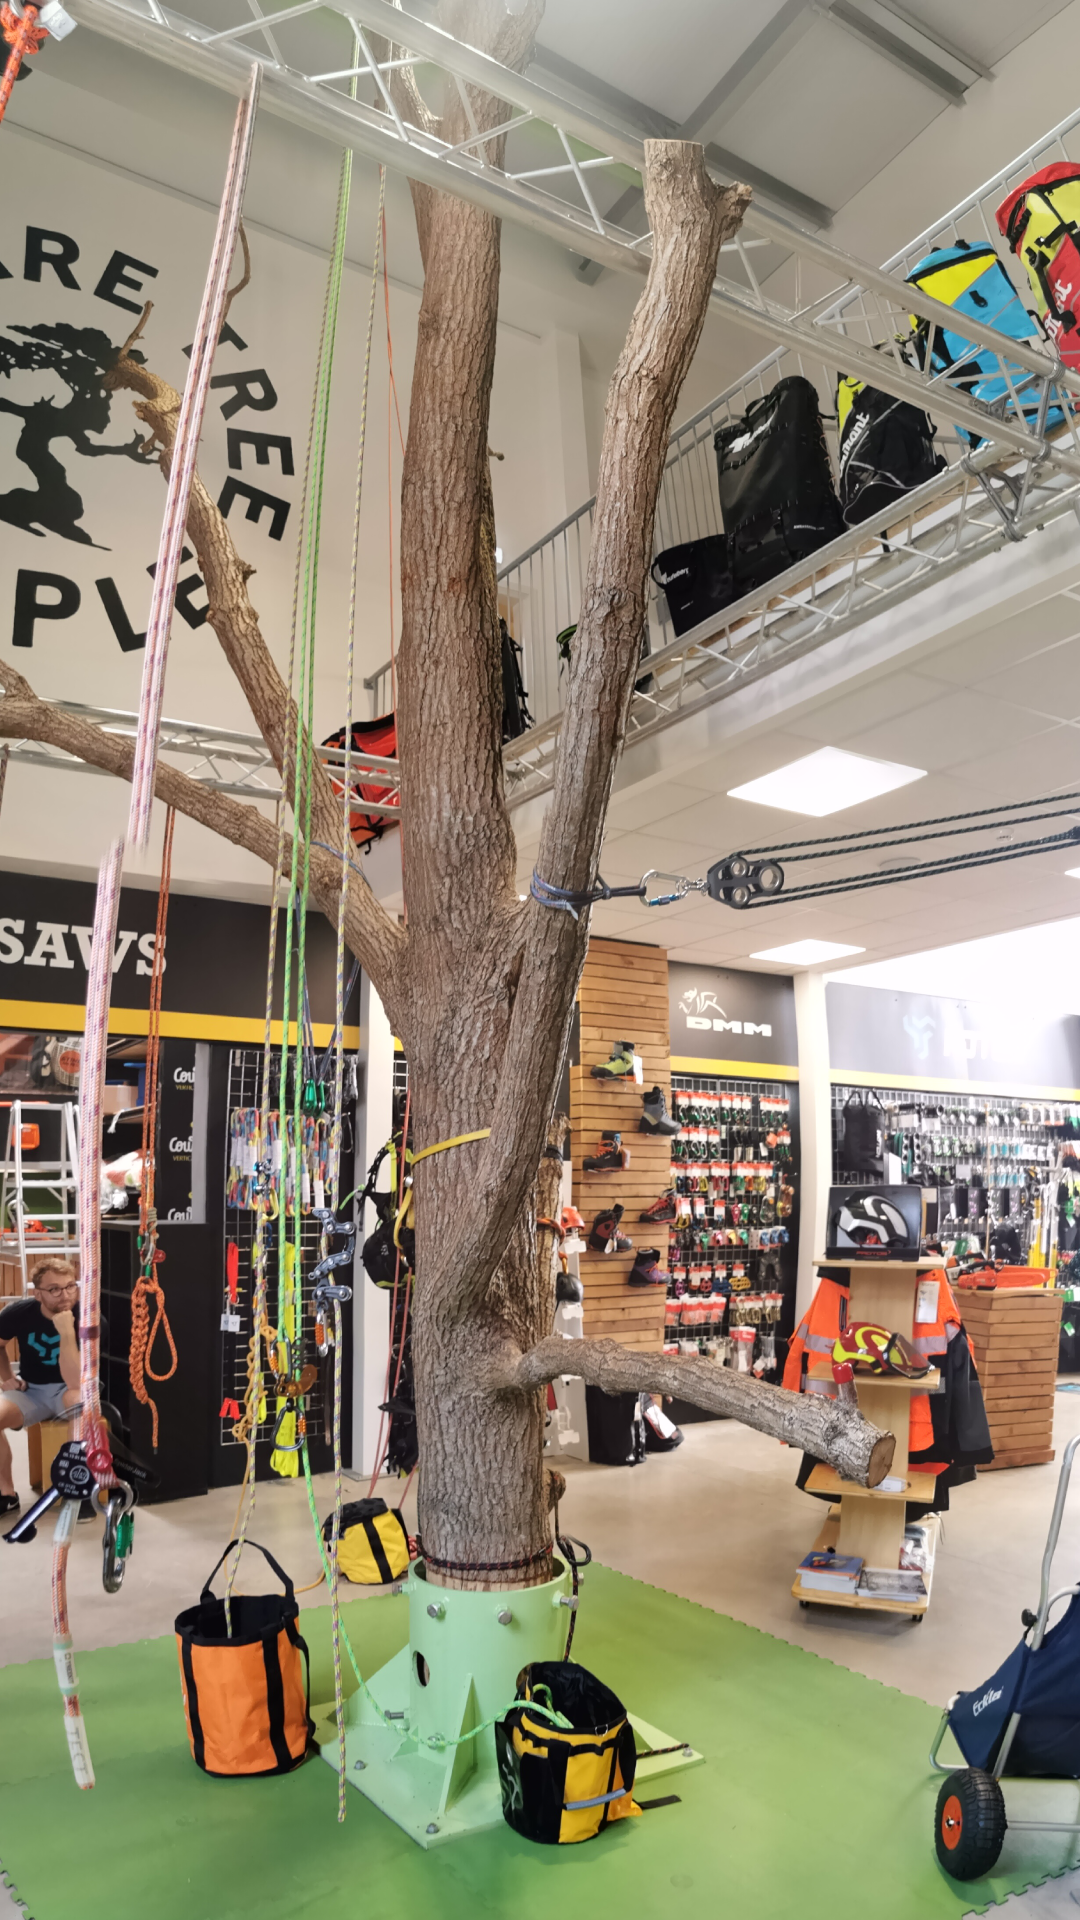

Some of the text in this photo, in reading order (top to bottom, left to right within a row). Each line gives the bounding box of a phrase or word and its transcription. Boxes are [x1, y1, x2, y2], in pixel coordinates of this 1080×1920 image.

[0, 226, 159, 316] RE
[686, 1016, 772, 1037] DMM
[173, 1067, 196, 1083] Cou
